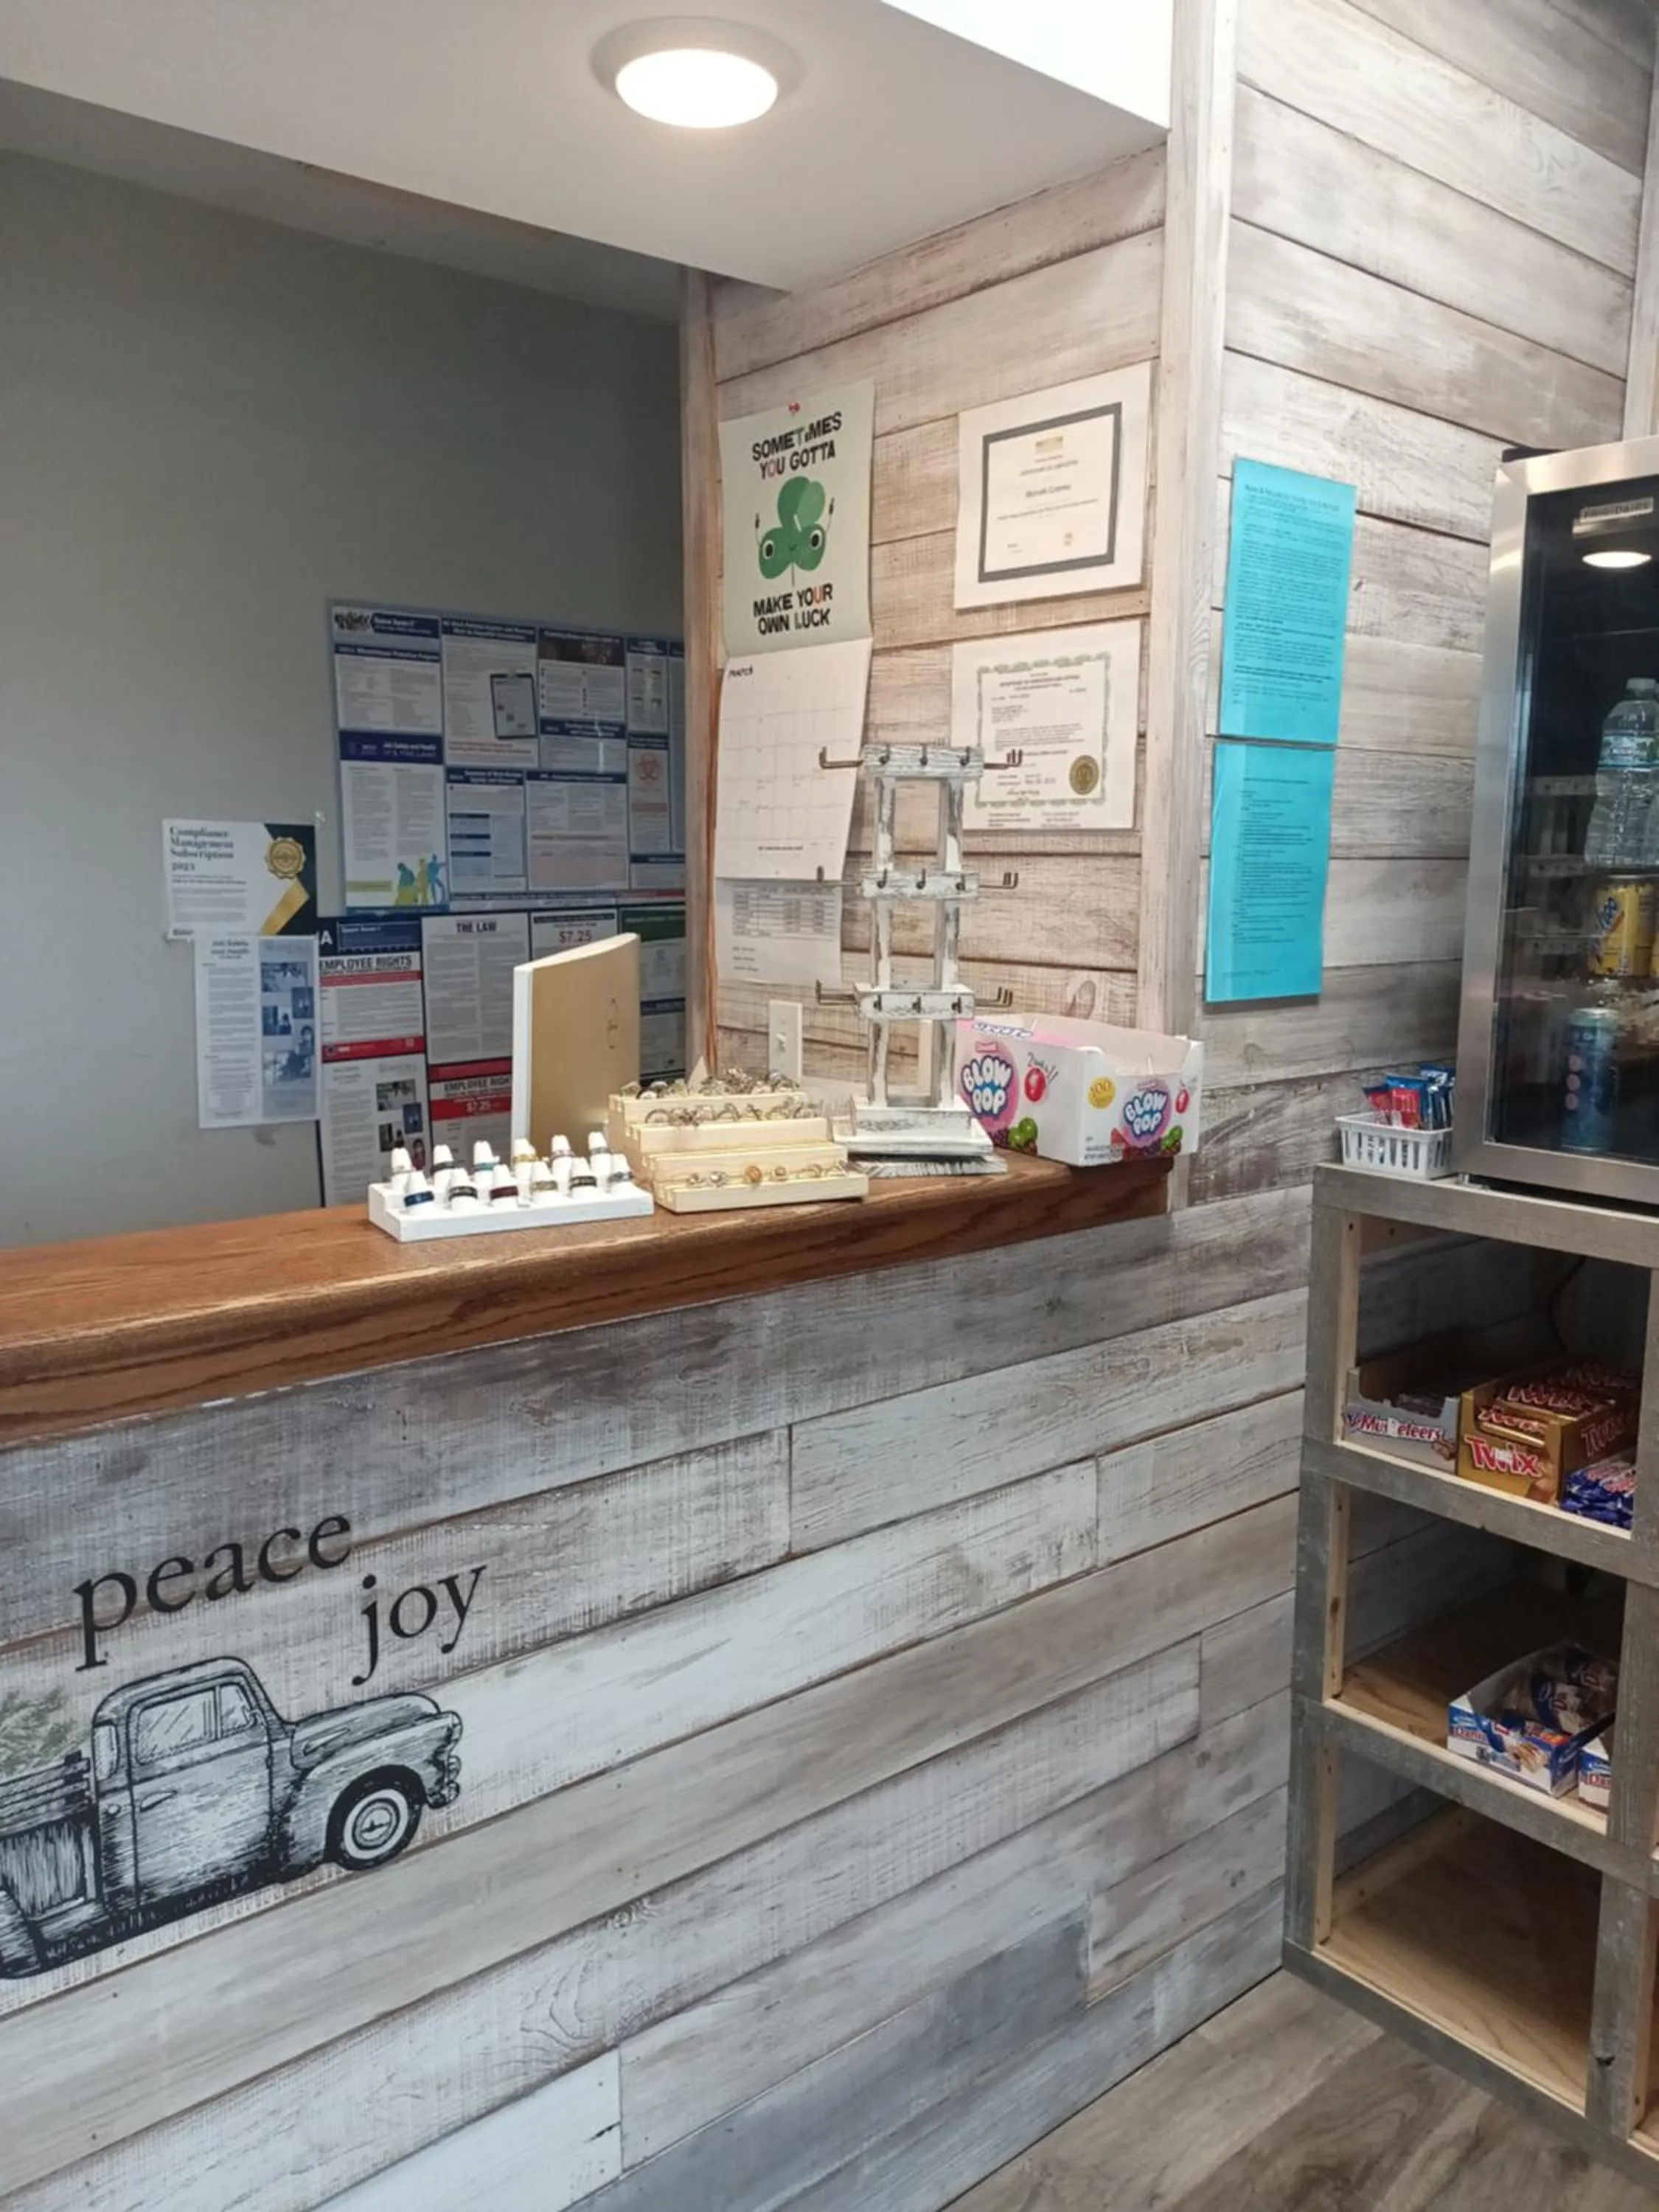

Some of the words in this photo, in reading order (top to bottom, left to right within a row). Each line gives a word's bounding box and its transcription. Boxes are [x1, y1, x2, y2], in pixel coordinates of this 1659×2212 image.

[759, 456, 785, 480] YOU
[790, 439, 835, 470] GOTTA
[753, 592, 793, 617] MAKE
[796, 582, 832, 608] YOUR
[758, 613, 790, 635] OWN
[794, 608, 830, 630] LUCK
[170, 827, 228, 840] Compliance
[171, 837, 234, 849] Management
[170, 848, 234, 861] Subscription
[456, 922, 473, 933] THE
[476, 921, 496, 933] LAW
[559, 929, 592, 945] $7.25
[319, 957, 372, 971] EMPLOYEE
[376, 955, 412, 970] RIGHTS
[445, 1079, 487, 1091] EMPLOYEE
[961, 1055, 1014, 1093] BLOW
[972, 1086, 1007, 1116] POP
[1124, 1091, 1168, 1121] BLOW
[1133, 1112, 1163, 1135] POP
[1360, 1413, 1444, 1441] Museteers
[74, 1514, 352, 1672] peace
[351, 1565, 487, 1686] joy
